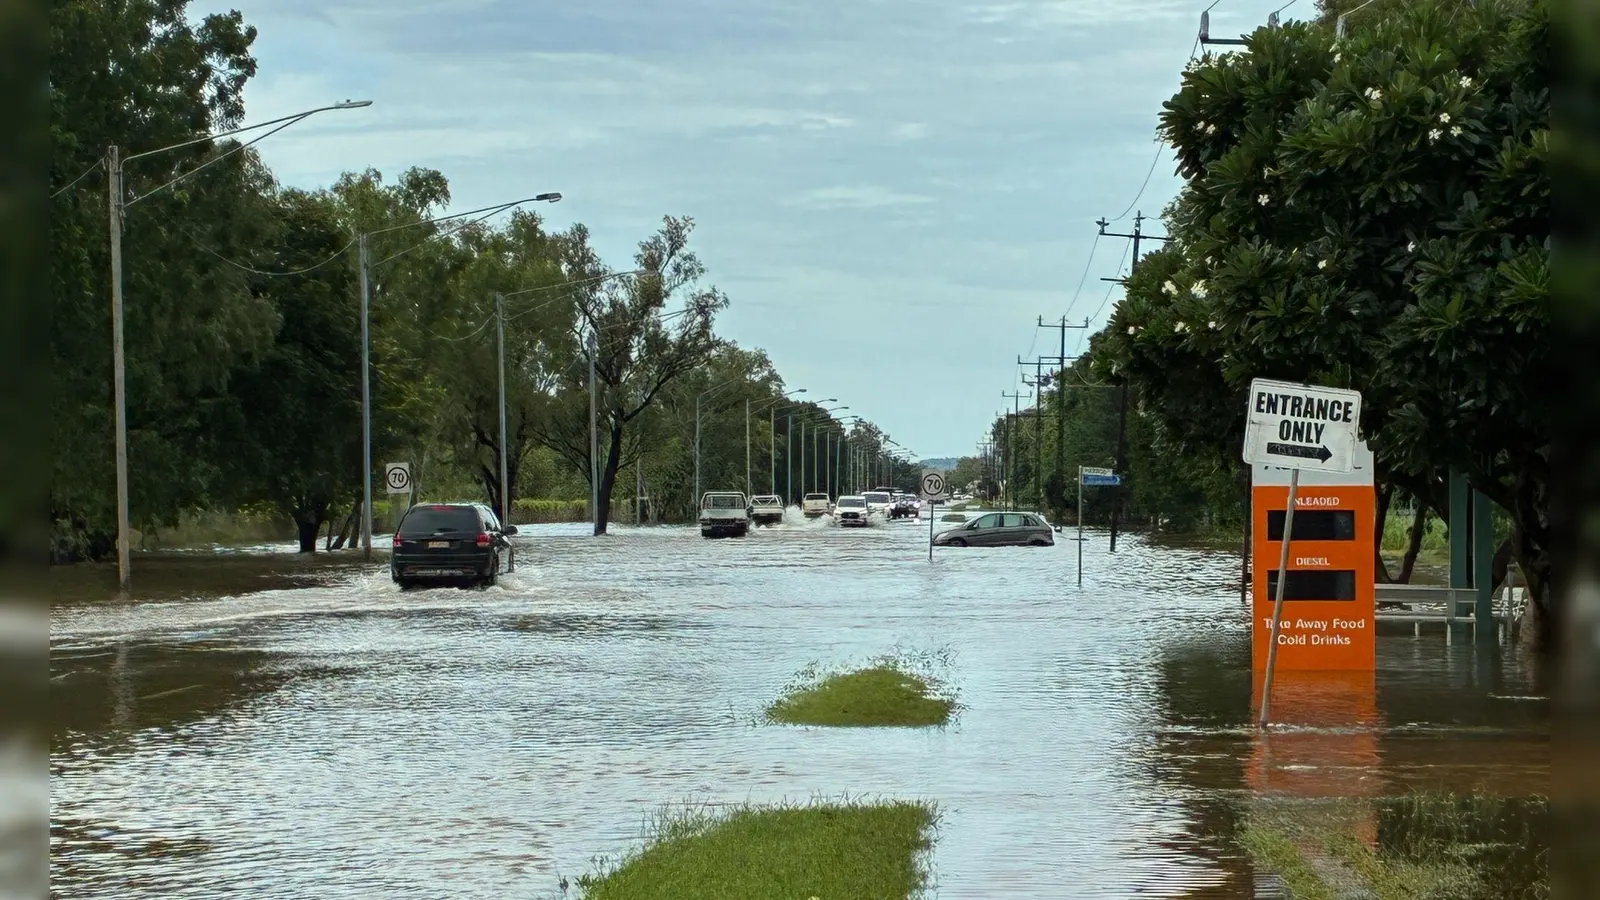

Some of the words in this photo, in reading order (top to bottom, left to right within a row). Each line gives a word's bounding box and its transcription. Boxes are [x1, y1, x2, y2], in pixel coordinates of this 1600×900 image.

[1255, 391, 1354, 423] ENTRANCE
[1278, 419, 1325, 444] ONLY
[391, 472, 404, 483] 70
[926, 478, 941, 490] 70
[1286, 496, 1340, 506] NLEADED
[1295, 557, 1331, 566] DIESEL
[1295, 618, 1328, 631] Away
[1332, 618, 1365, 629] Food
[1277, 634, 1306, 645] Cold
[1311, 634, 1351, 645] Drinks
